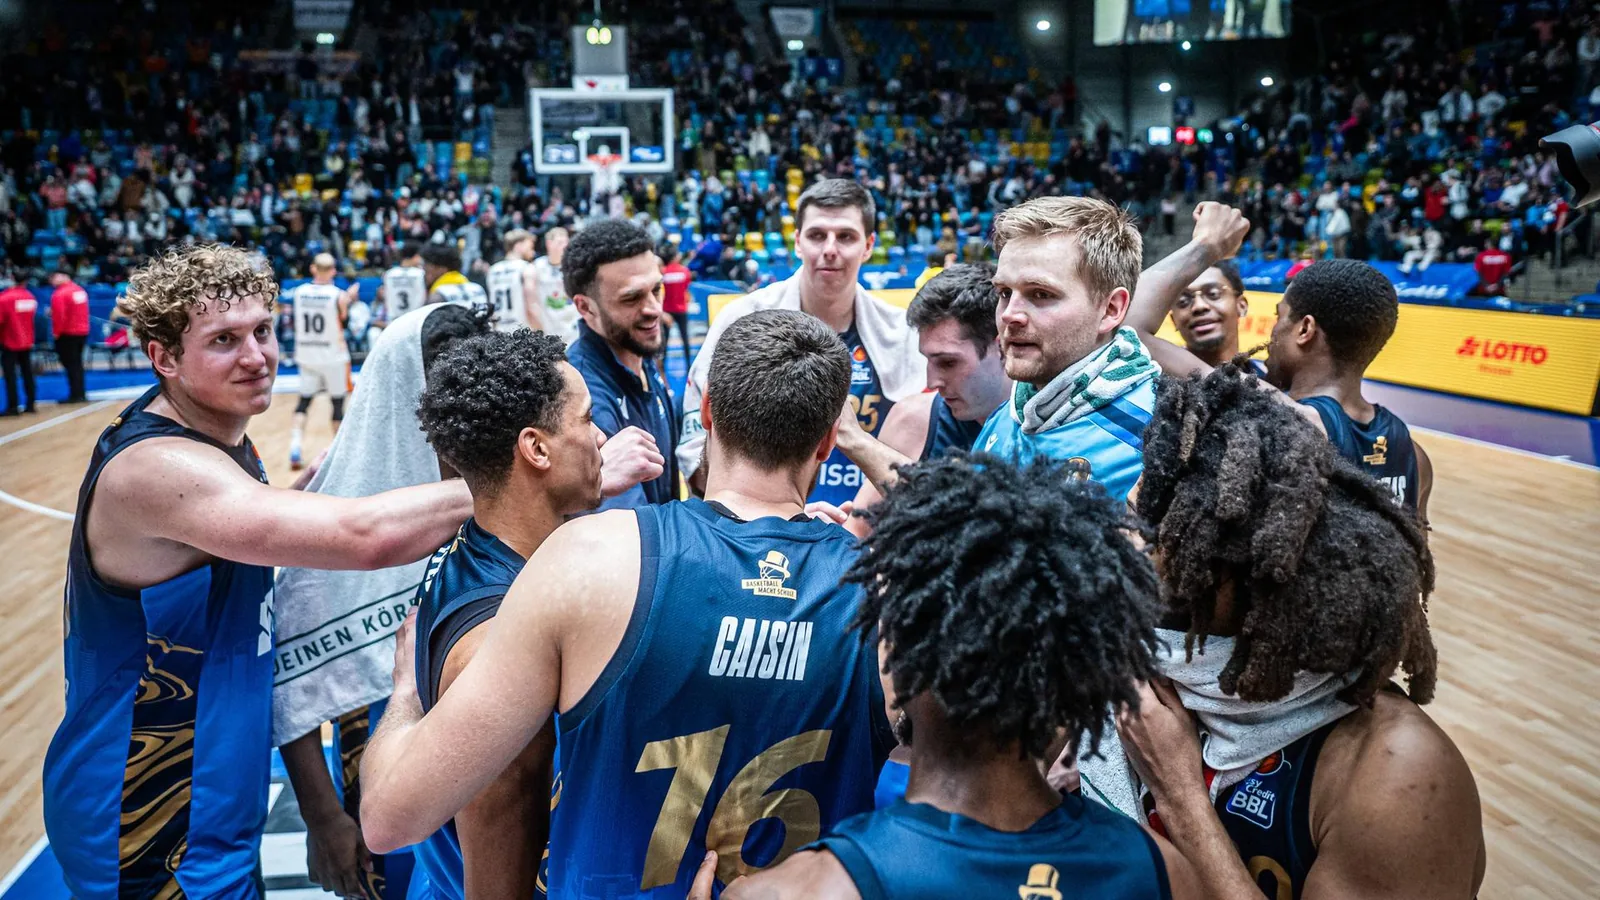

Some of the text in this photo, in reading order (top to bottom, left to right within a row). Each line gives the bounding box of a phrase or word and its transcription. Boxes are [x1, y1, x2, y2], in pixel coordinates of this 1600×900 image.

[397, 291, 410, 310] 3
[303, 312, 325, 334] 10
[1481, 339, 1548, 365] LOTTO
[746, 580, 779, 588] BASKETBALL
[758, 587, 795, 598] MACHT SCHULE
[708, 616, 813, 681] CAISIN
[1245, 784, 1276, 802] Credit
[635, 724, 832, 891] 16
[1231, 790, 1268, 820] BBL
